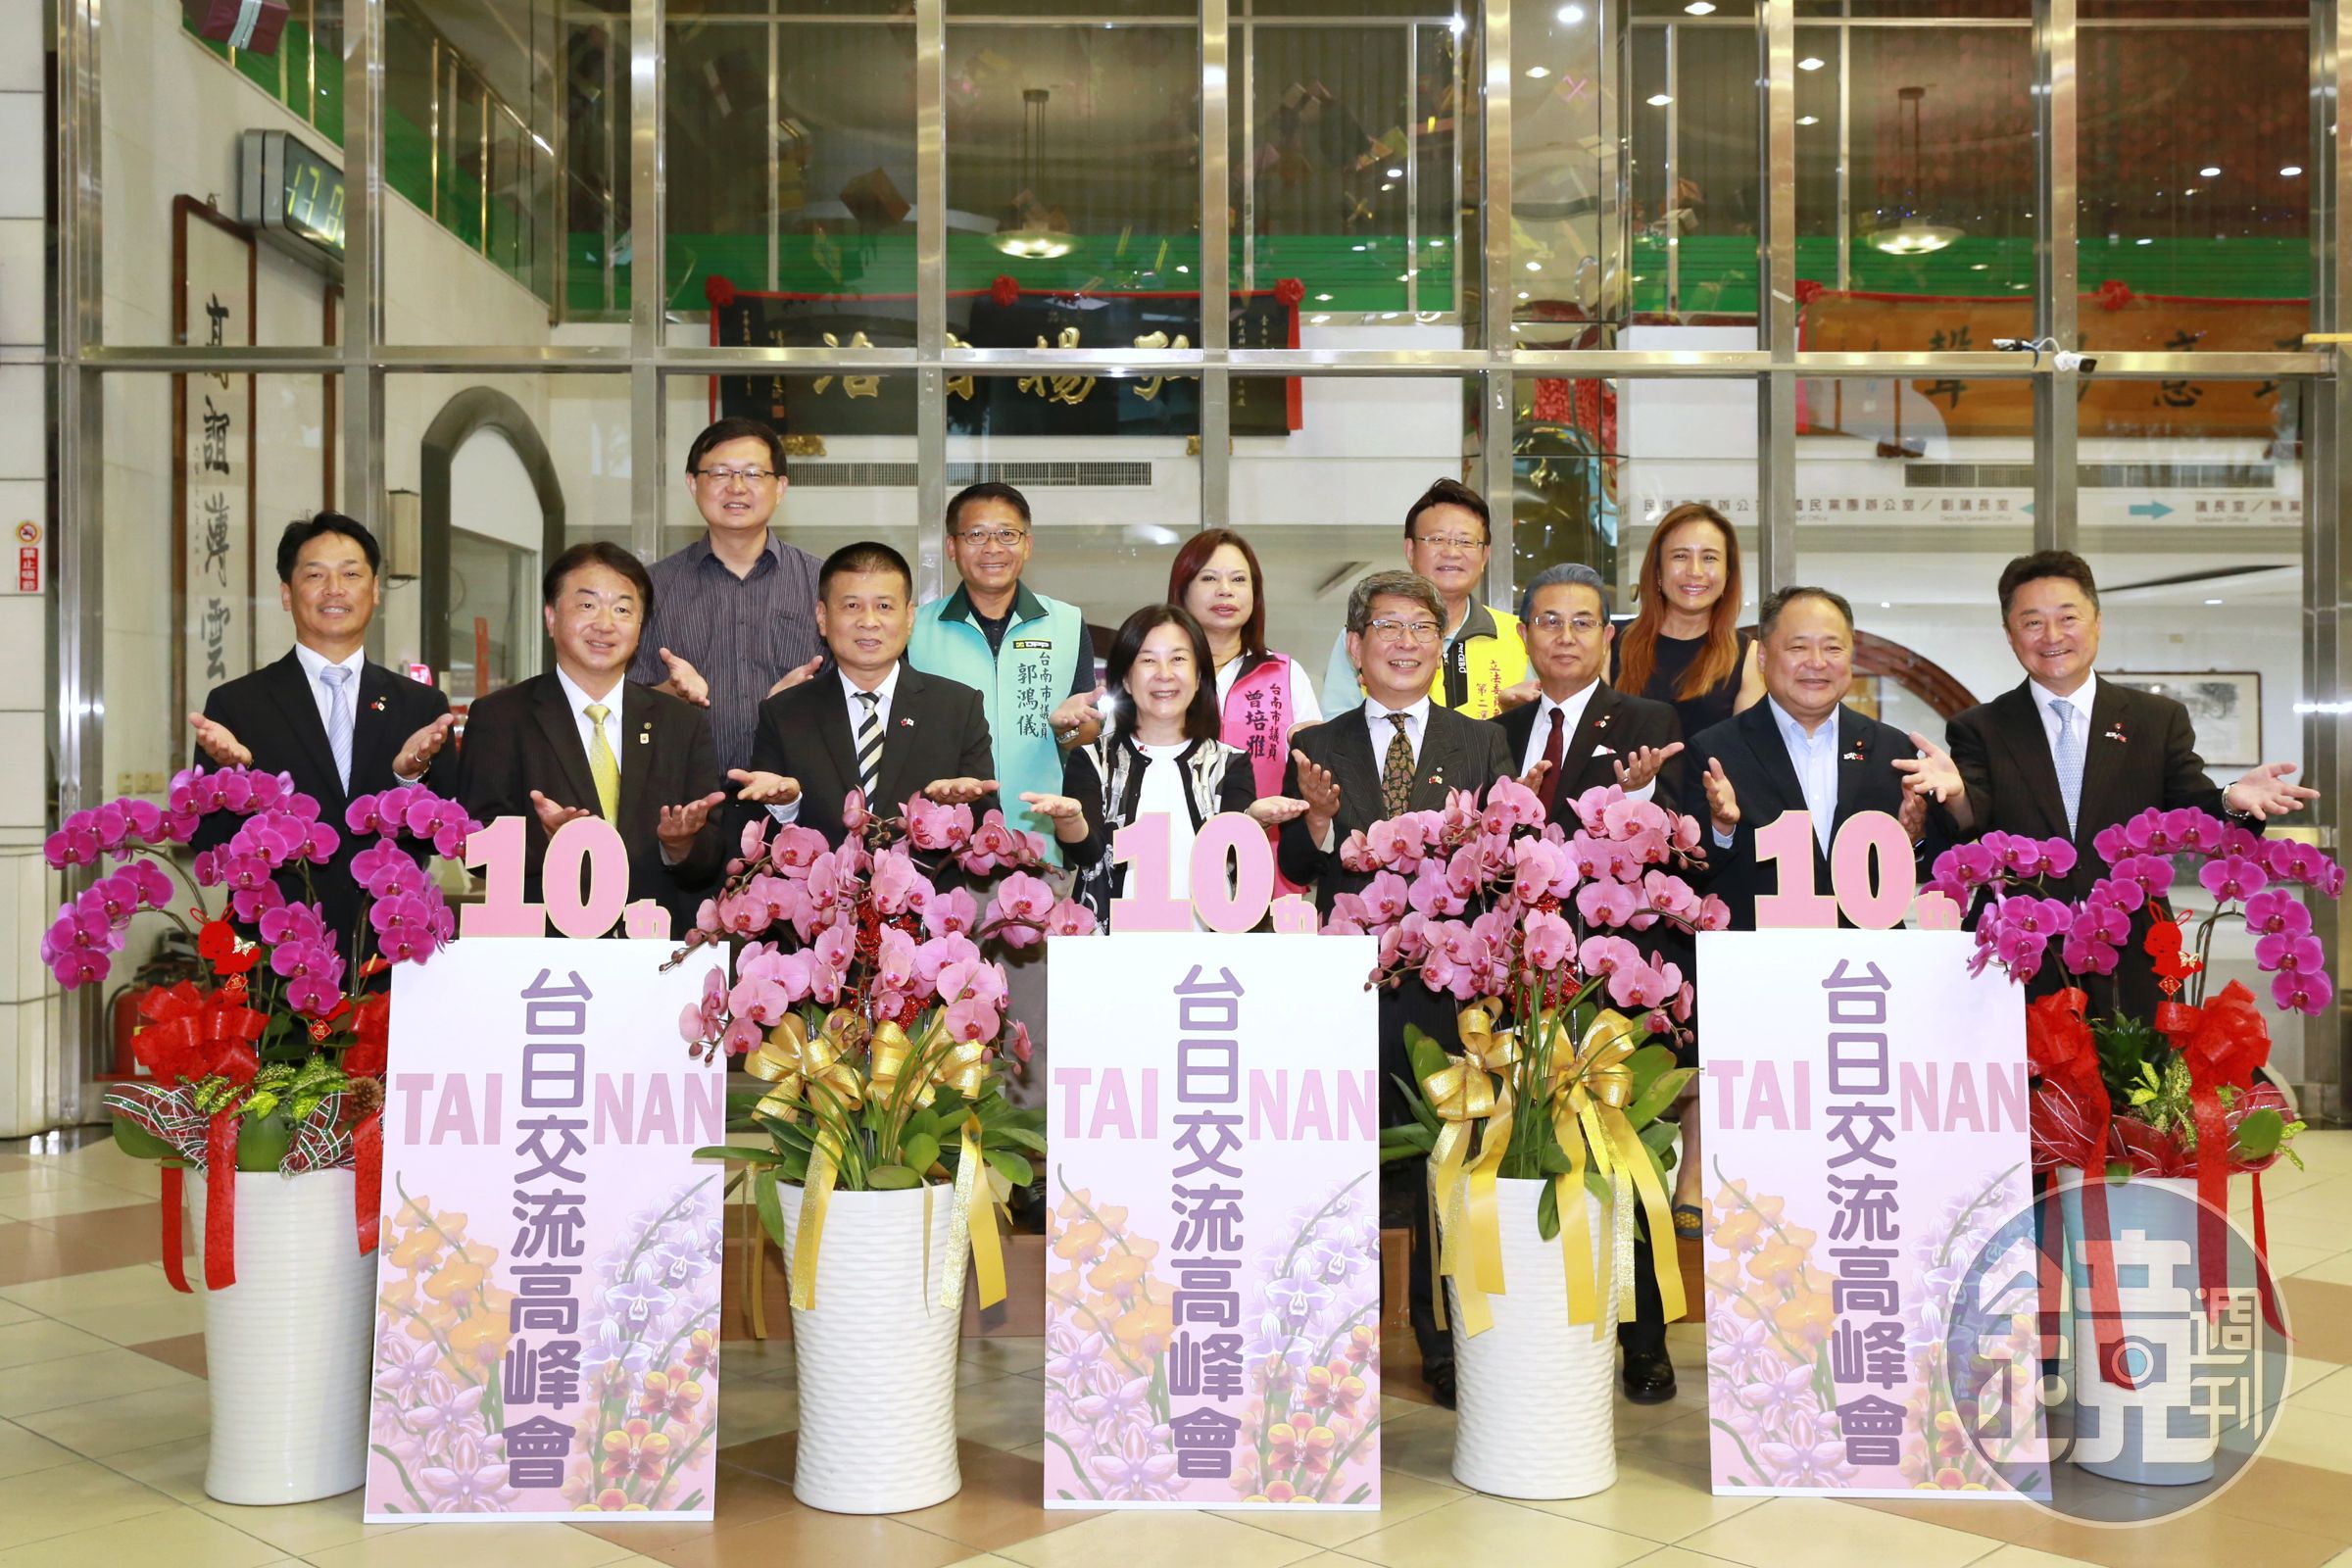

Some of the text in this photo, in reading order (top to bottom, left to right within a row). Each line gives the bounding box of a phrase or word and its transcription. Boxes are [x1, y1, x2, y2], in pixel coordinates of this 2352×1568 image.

[1016, 662, 1039, 738] 郭鴻儀
[1040, 652, 1053, 740] 台南市議員
[1245, 690, 1268, 759] 曾培雅
[1267, 683, 1282, 761] 台南市議員
[396, 1073, 723, 1145] TAI NAN
[1054, 1068, 1376, 1141] TAI NAN
[1707, 1060, 2027, 1132] TAI NAN
[502, 968, 593, 1488] 台日交流高峰會
[1169, 964, 1245, 1478] 台日交流高峰會
[1822, 958, 1907, 1465] 台日交流高峰會
